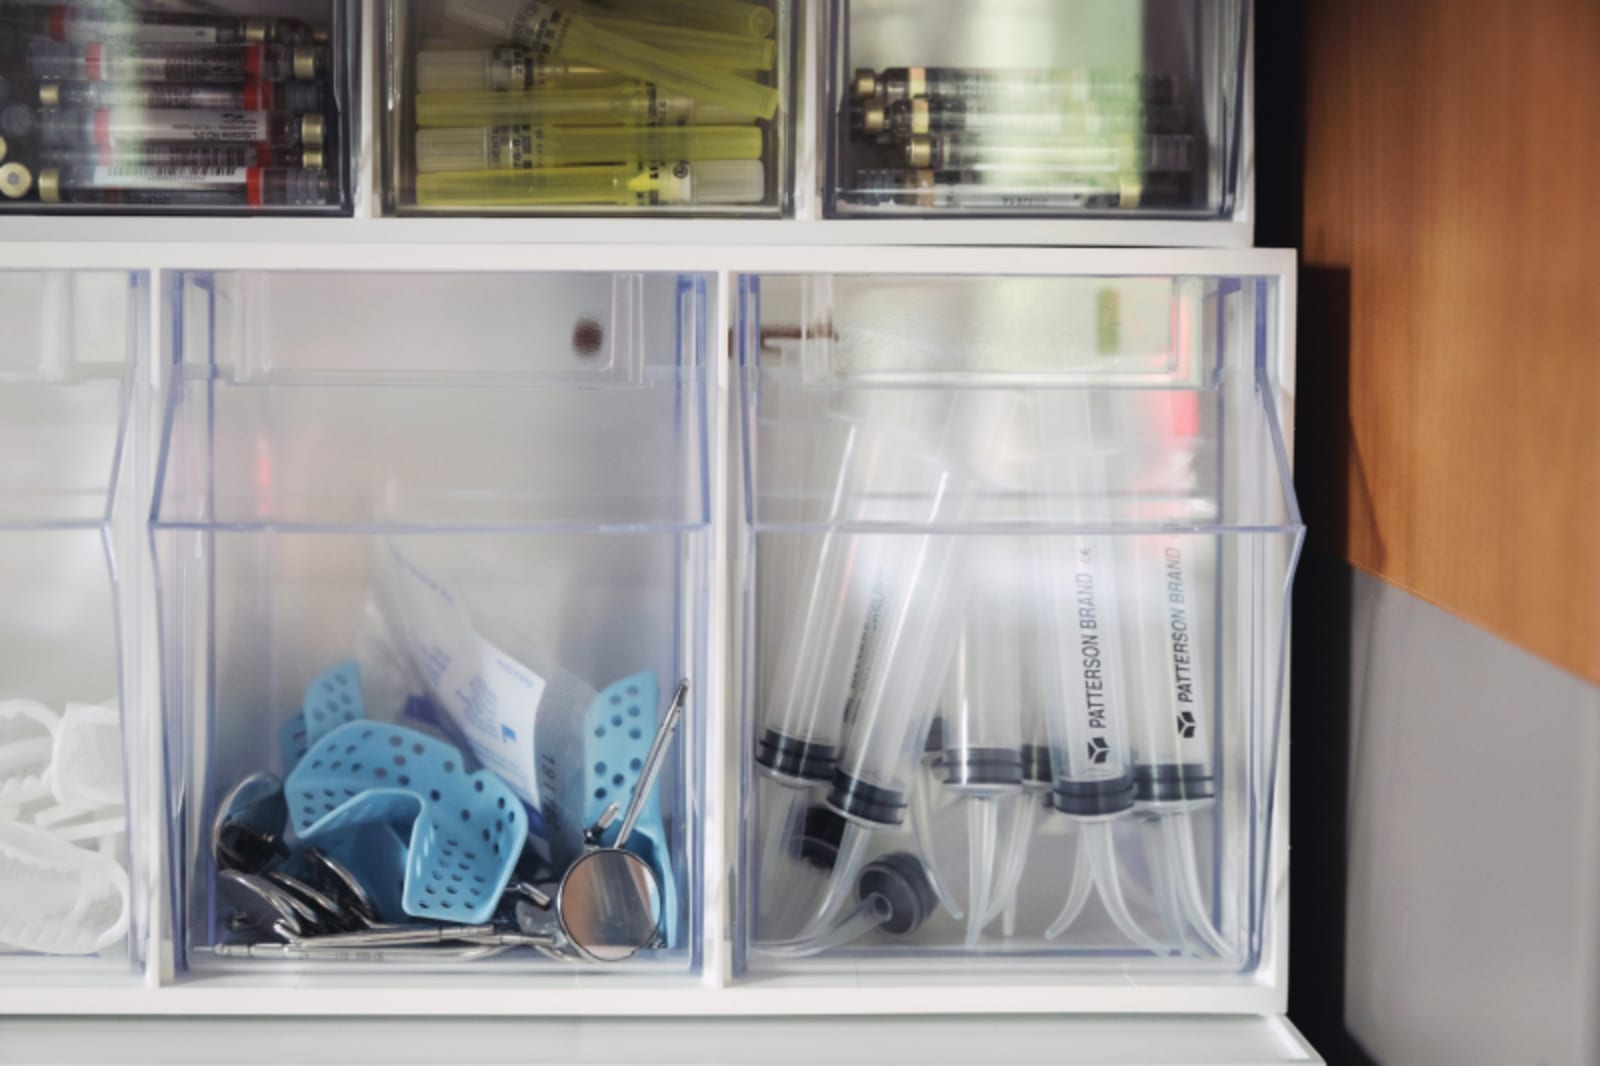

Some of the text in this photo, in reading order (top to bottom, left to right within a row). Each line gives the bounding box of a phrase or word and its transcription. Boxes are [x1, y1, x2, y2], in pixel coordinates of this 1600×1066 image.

[1075, 573, 1097, 631] BRAND
[1164, 546, 1193, 704] PATTERSON BRAND
[1080, 634, 1106, 730] PATTERSON
